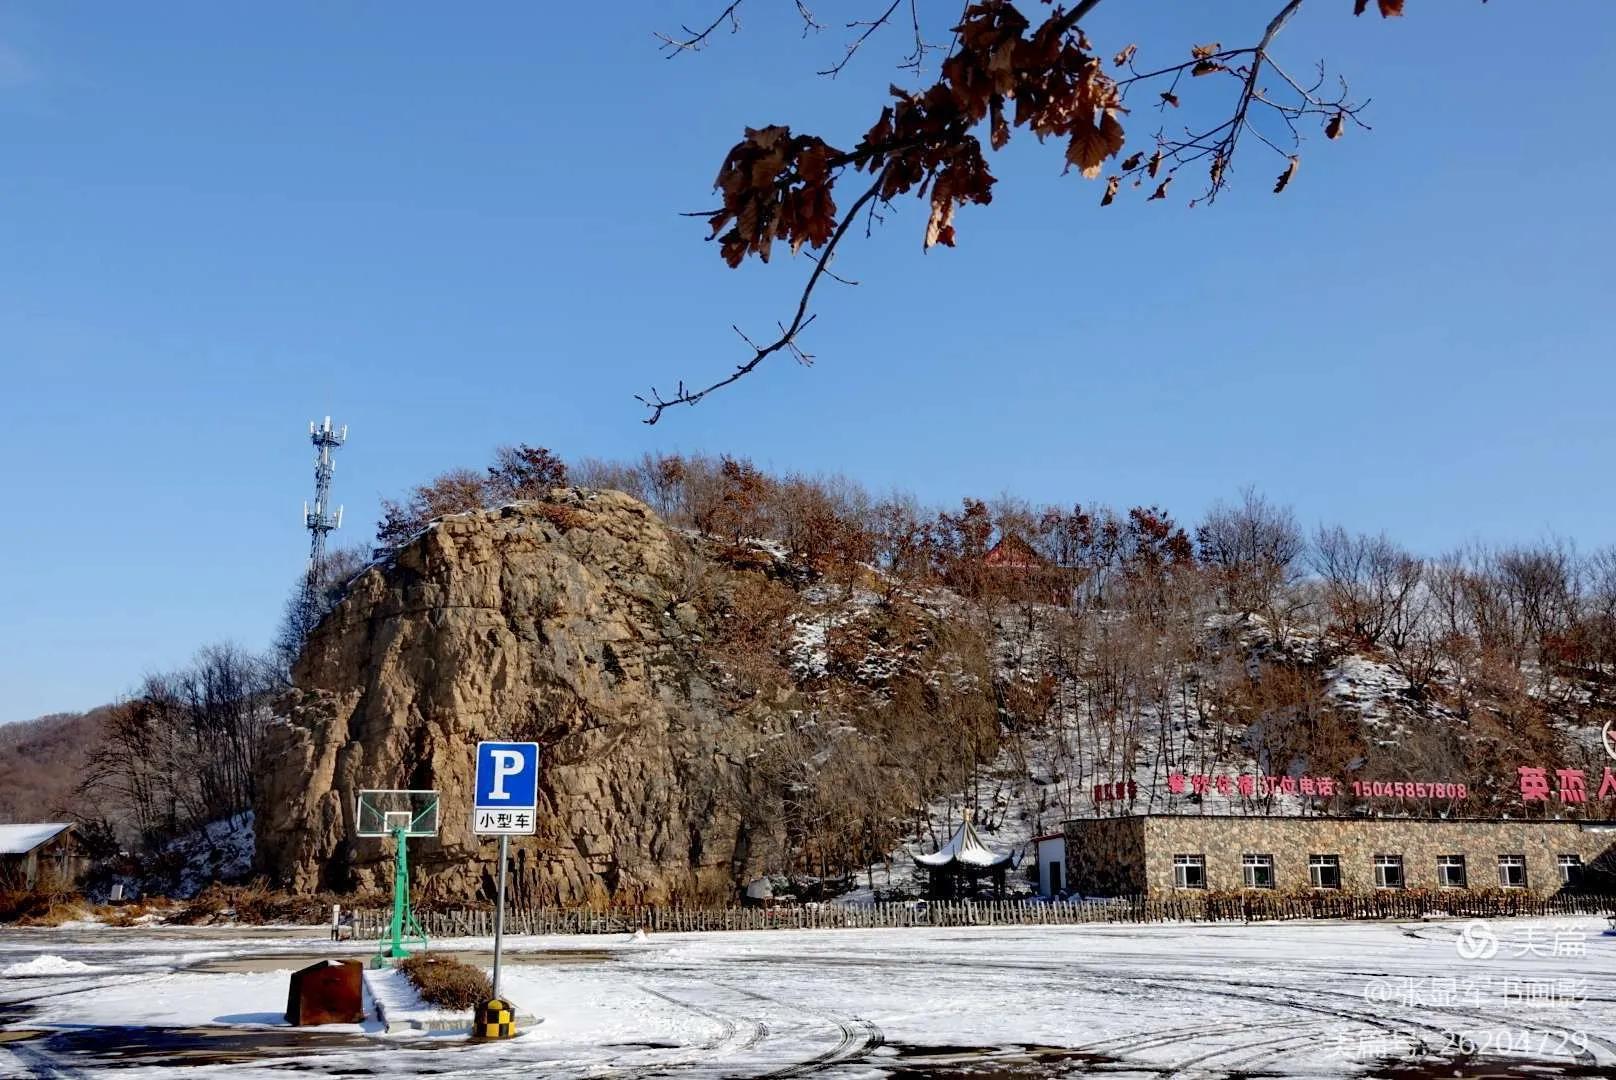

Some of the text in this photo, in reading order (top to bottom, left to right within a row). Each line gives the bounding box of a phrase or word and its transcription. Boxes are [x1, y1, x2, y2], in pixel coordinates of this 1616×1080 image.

[488, 750, 525, 799] P
[1352, 780, 1467, 799] 15045857808
[480, 813, 529, 828] 小型车
